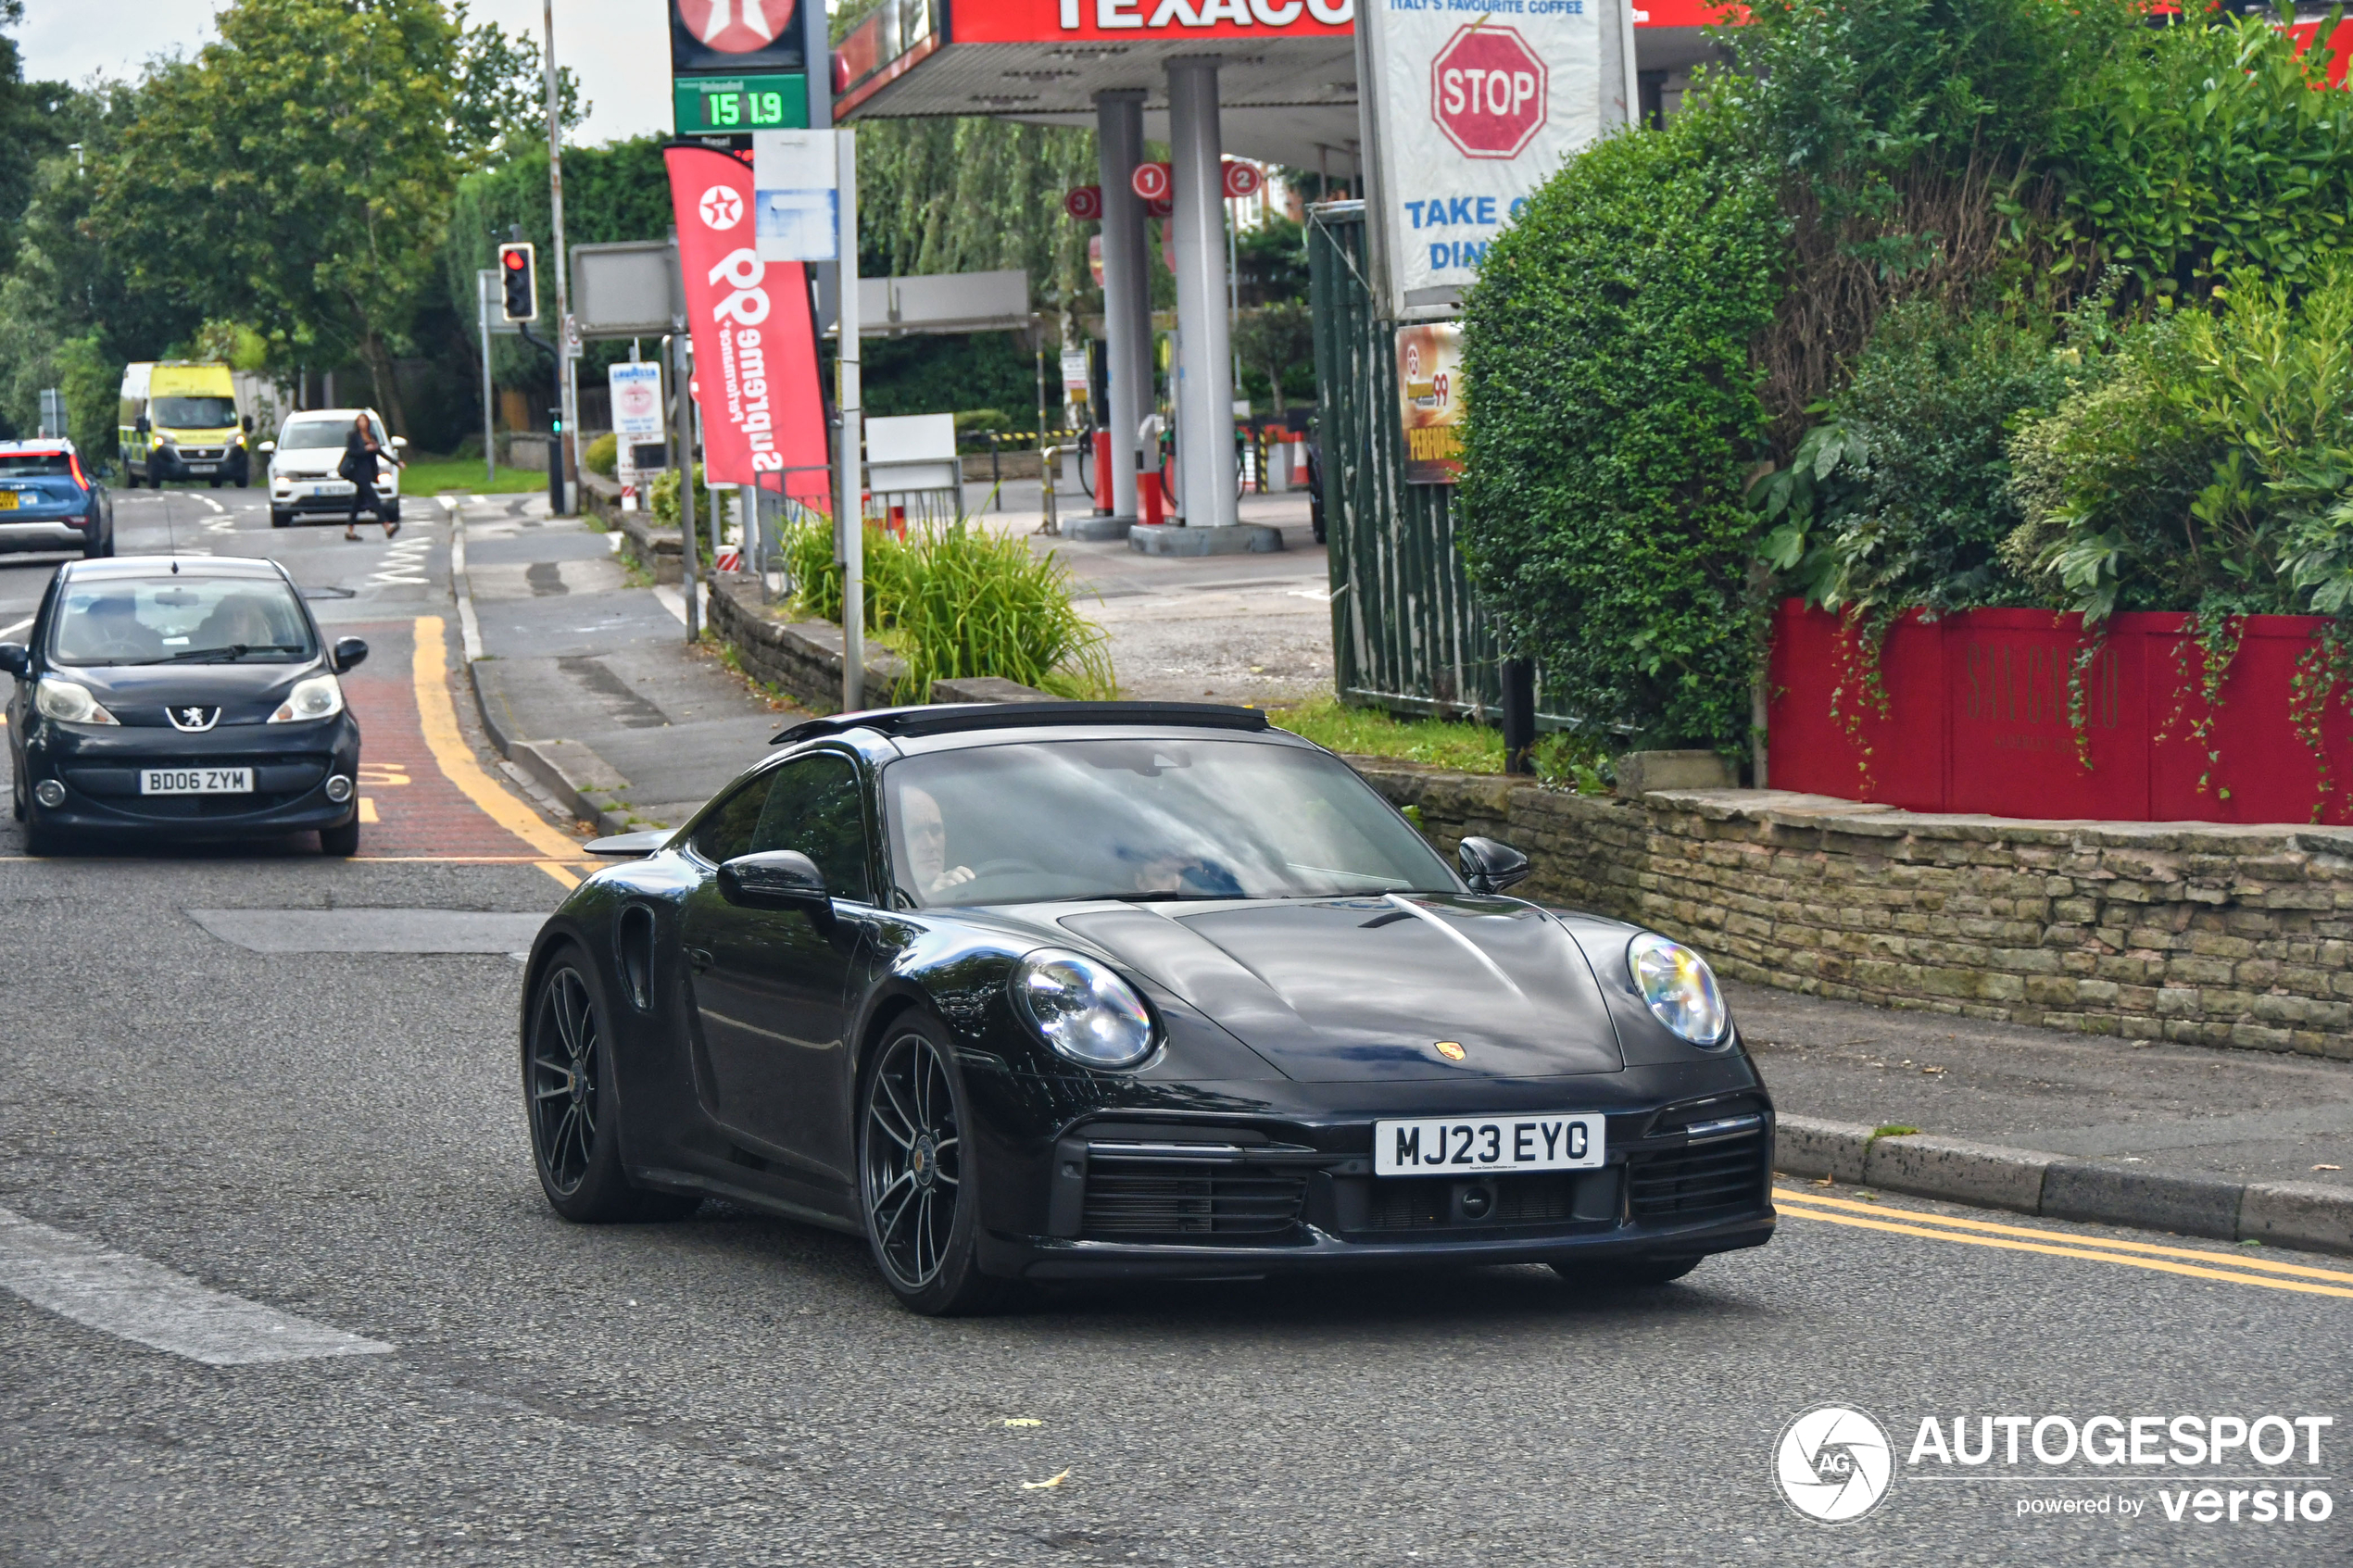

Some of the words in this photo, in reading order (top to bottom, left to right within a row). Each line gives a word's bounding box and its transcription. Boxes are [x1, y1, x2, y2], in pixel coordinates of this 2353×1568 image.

[1447, 0, 1524, 13] FAVOURITE
[1529, 0, 1584, 14] COFFEE
[1443, 68, 1535, 116] STOP
[1145, 172, 1154, 189] 1
[1236, 172, 1250, 187] 2
[1075, 194, 1087, 210] 3
[1404, 196, 1497, 229] TAKE
[149, 771, 200, 791] BD06
[207, 771, 245, 790] ZYM
[1395, 1123, 1501, 1167] MJ23
[1513, 1121, 1589, 1162] EYO
